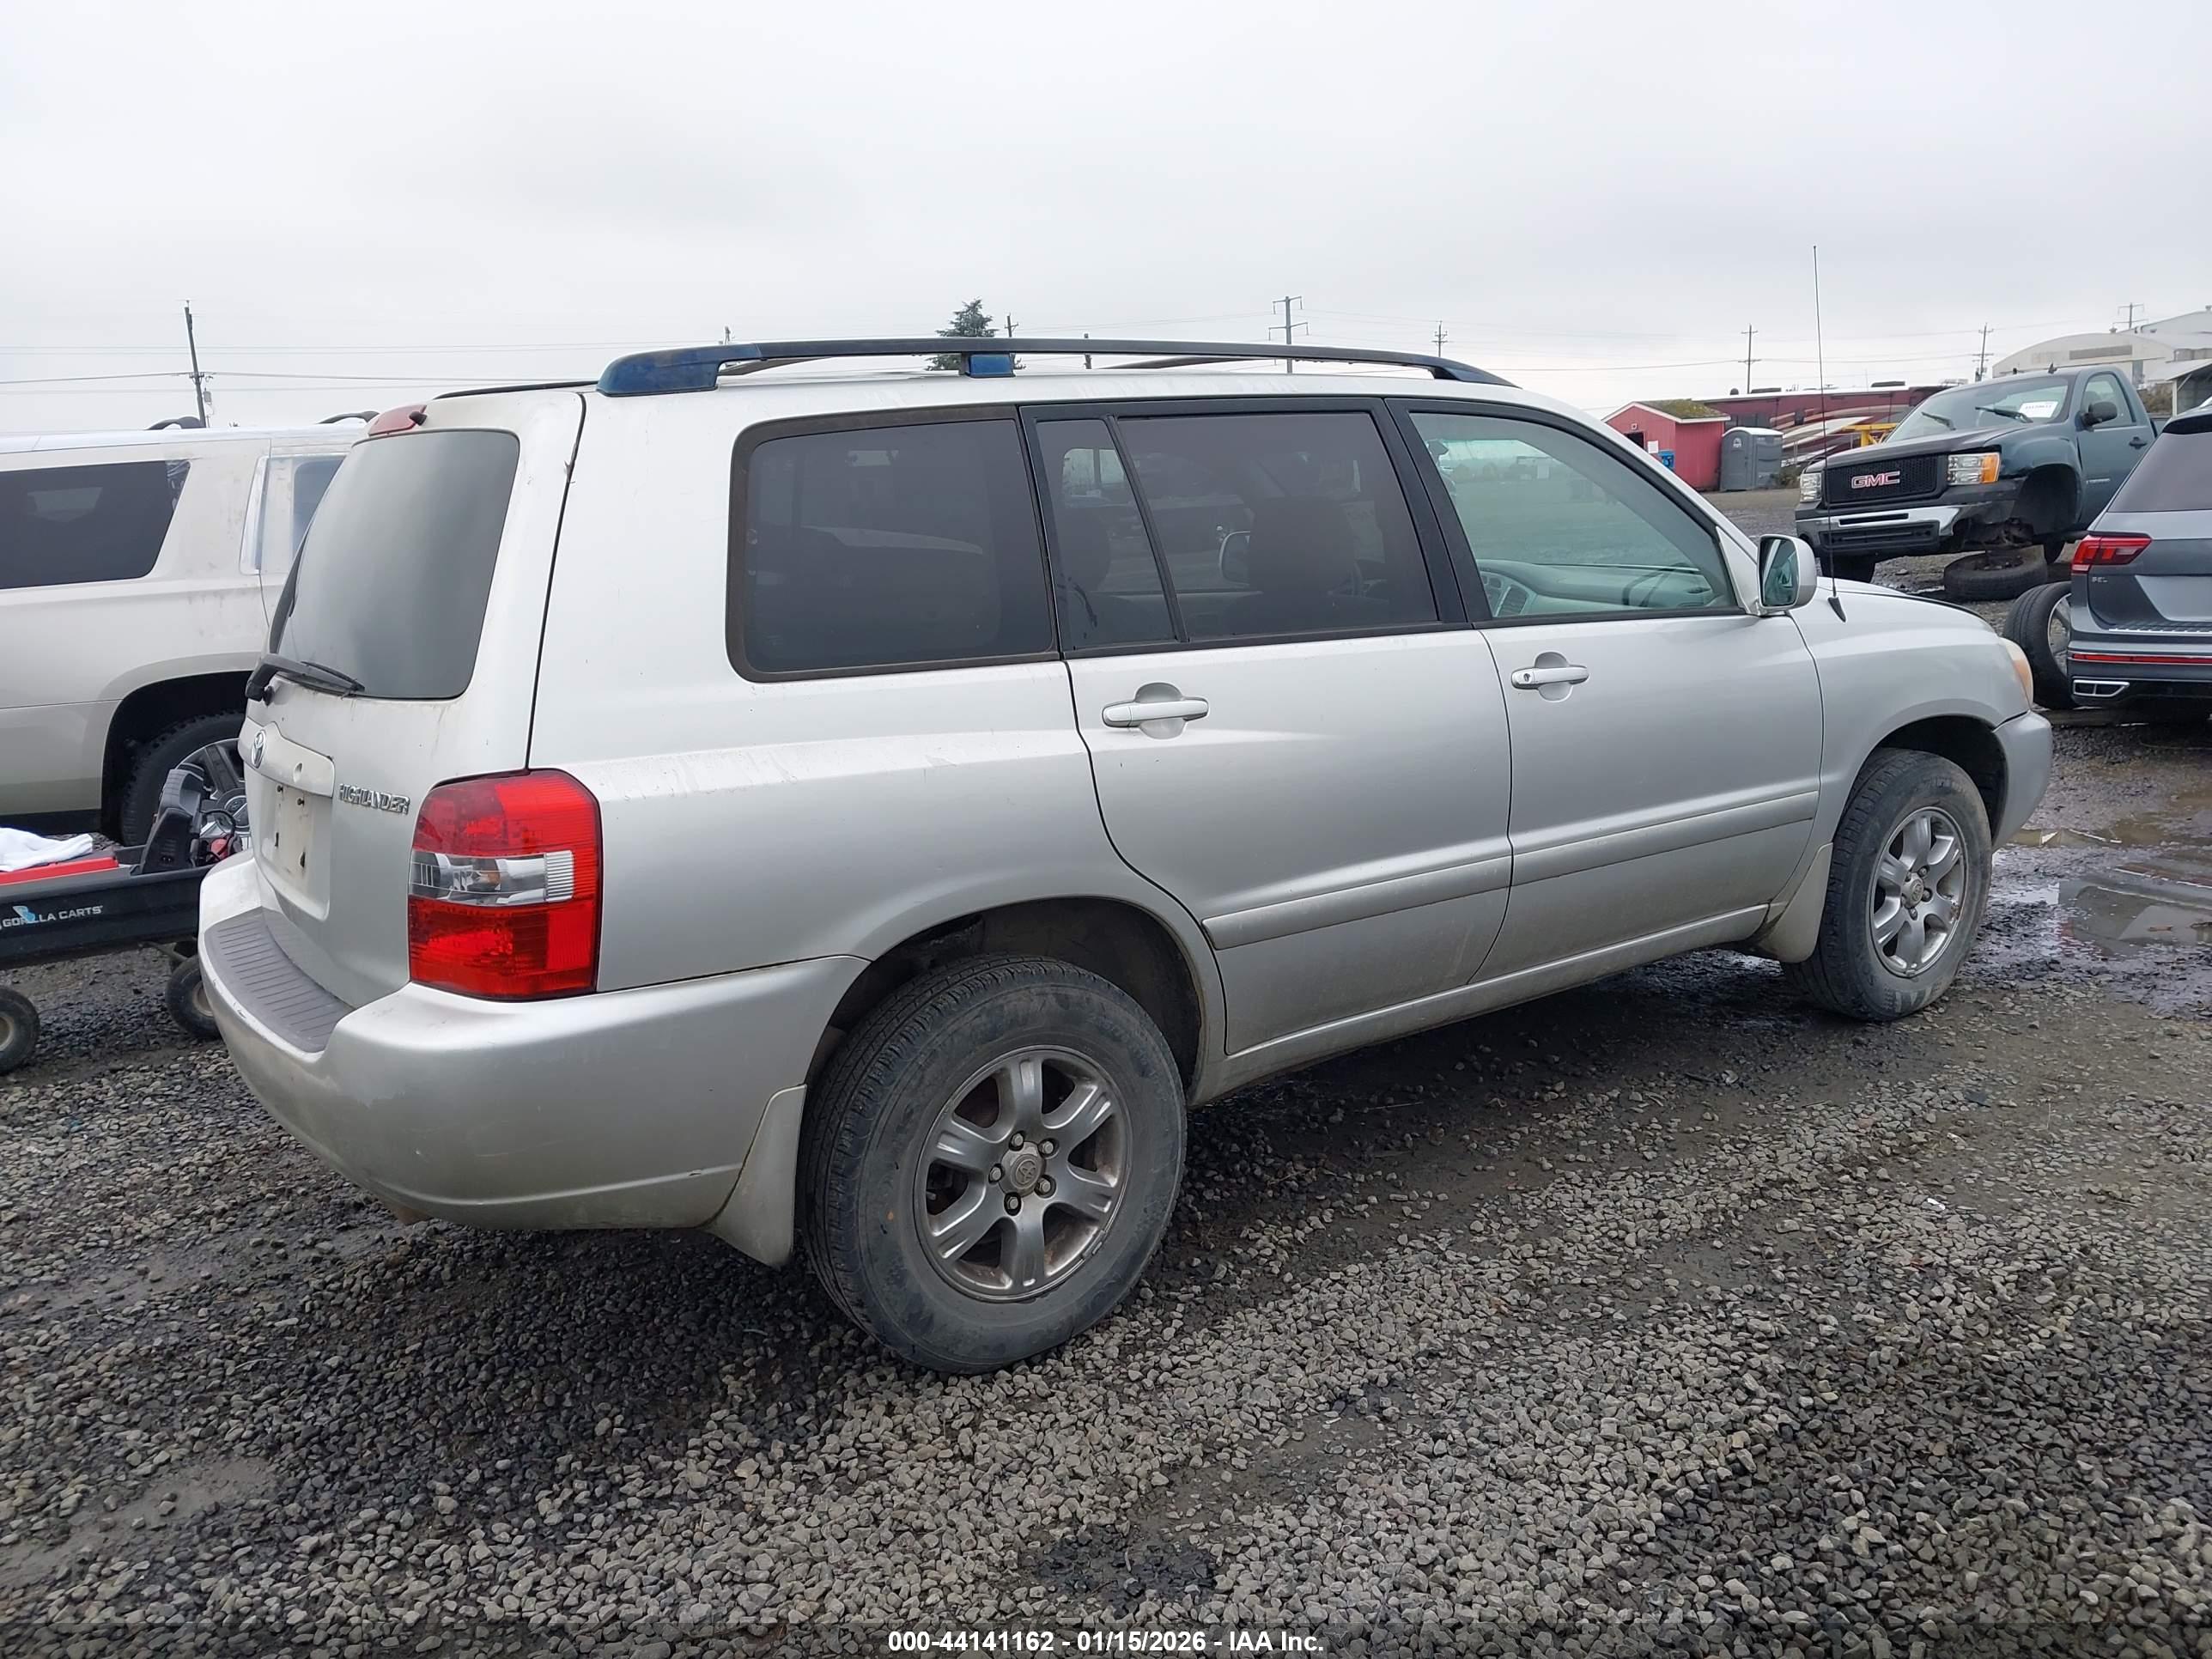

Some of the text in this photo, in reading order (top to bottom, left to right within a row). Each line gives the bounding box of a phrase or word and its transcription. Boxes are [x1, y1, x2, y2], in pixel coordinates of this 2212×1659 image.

[1851, 471, 1900, 489] GMC
[339, 783, 410, 815] HIGHLANDER
[3, 906, 102, 927] GORLA CARTS
